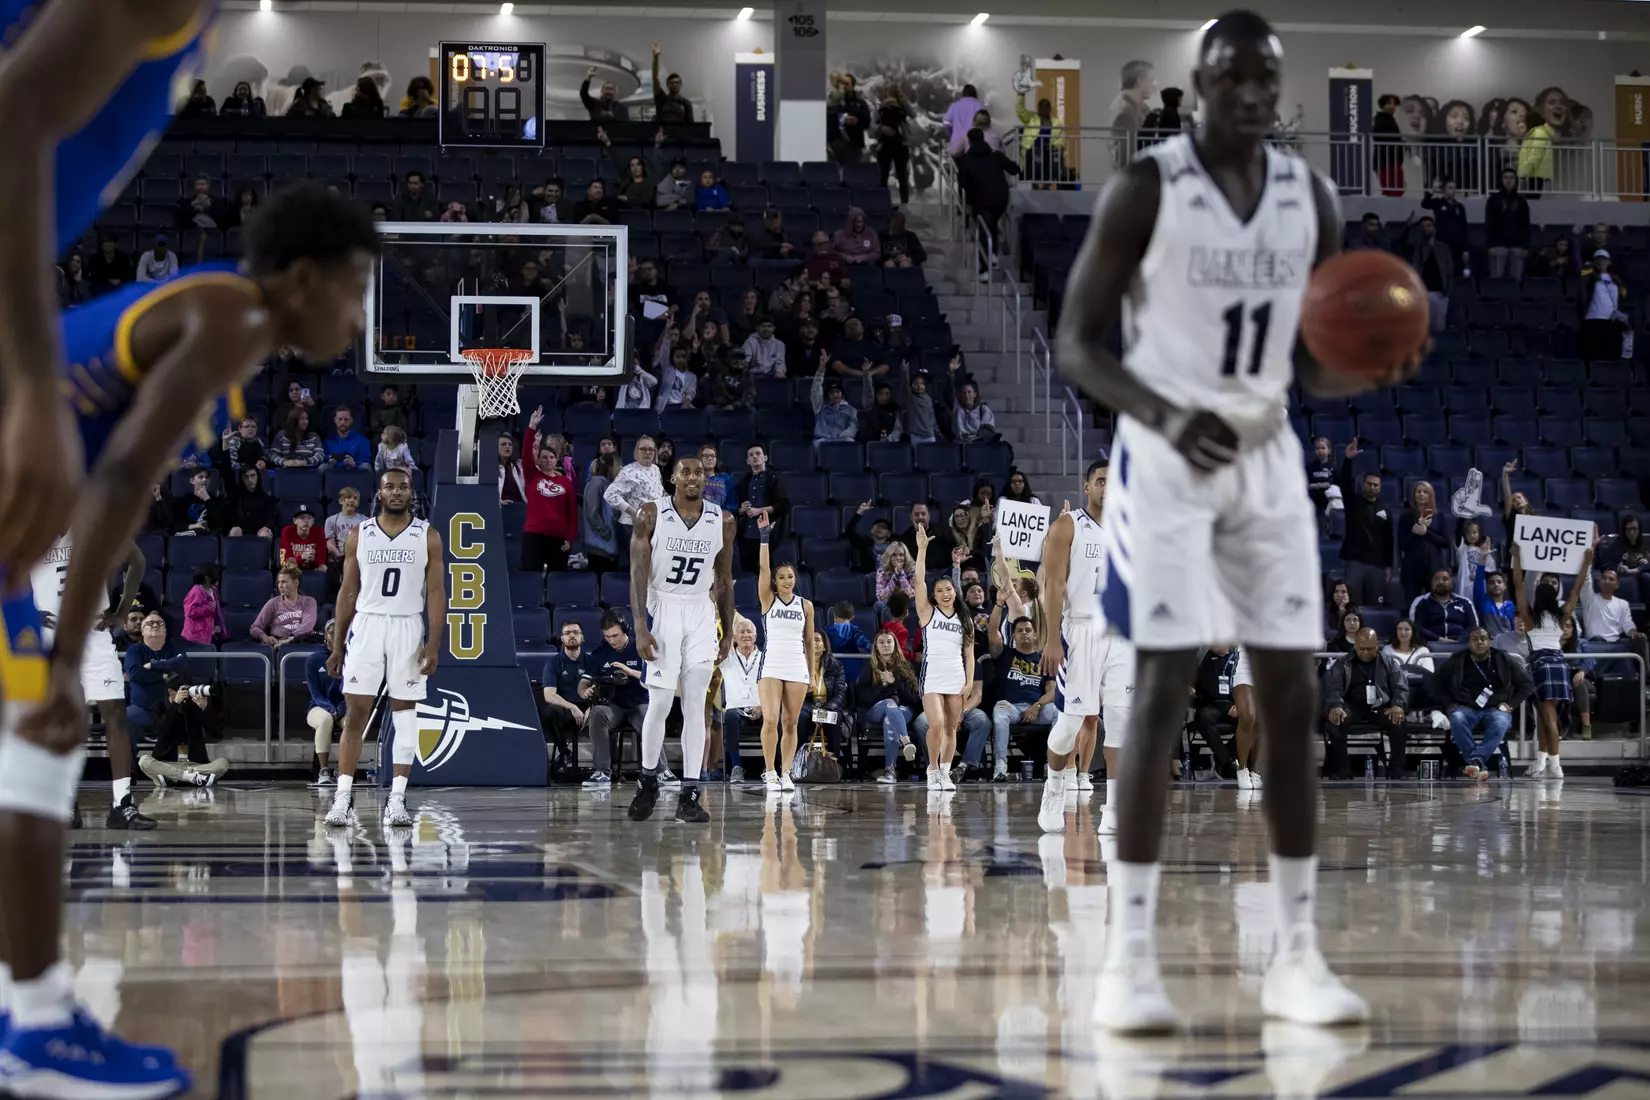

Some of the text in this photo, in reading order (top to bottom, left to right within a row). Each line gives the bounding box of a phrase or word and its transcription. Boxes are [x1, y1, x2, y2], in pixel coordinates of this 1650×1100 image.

[793, 15, 815, 26] 105
[793, 26, 814, 38] 106
[756, 70, 766, 121] BUSINESS
[1634, 93, 1643, 124] MUSIC
[1220, 300, 1272, 376] 11
[1001, 510, 1045, 532] LANCE
[1009, 530, 1032, 548] UP!
[1520, 525, 1587, 546] LANCE
[666, 537, 711, 554] LANCERS
[1534, 545, 1568, 563] UP!
[367, 549, 416, 564] LANCERS
[665, 555, 705, 586] 35
[381, 567, 401, 597] 0
[447, 512, 487, 660] CBU
[770, 608, 803, 621] LANCERS
[932, 619, 963, 634] LANCERS
